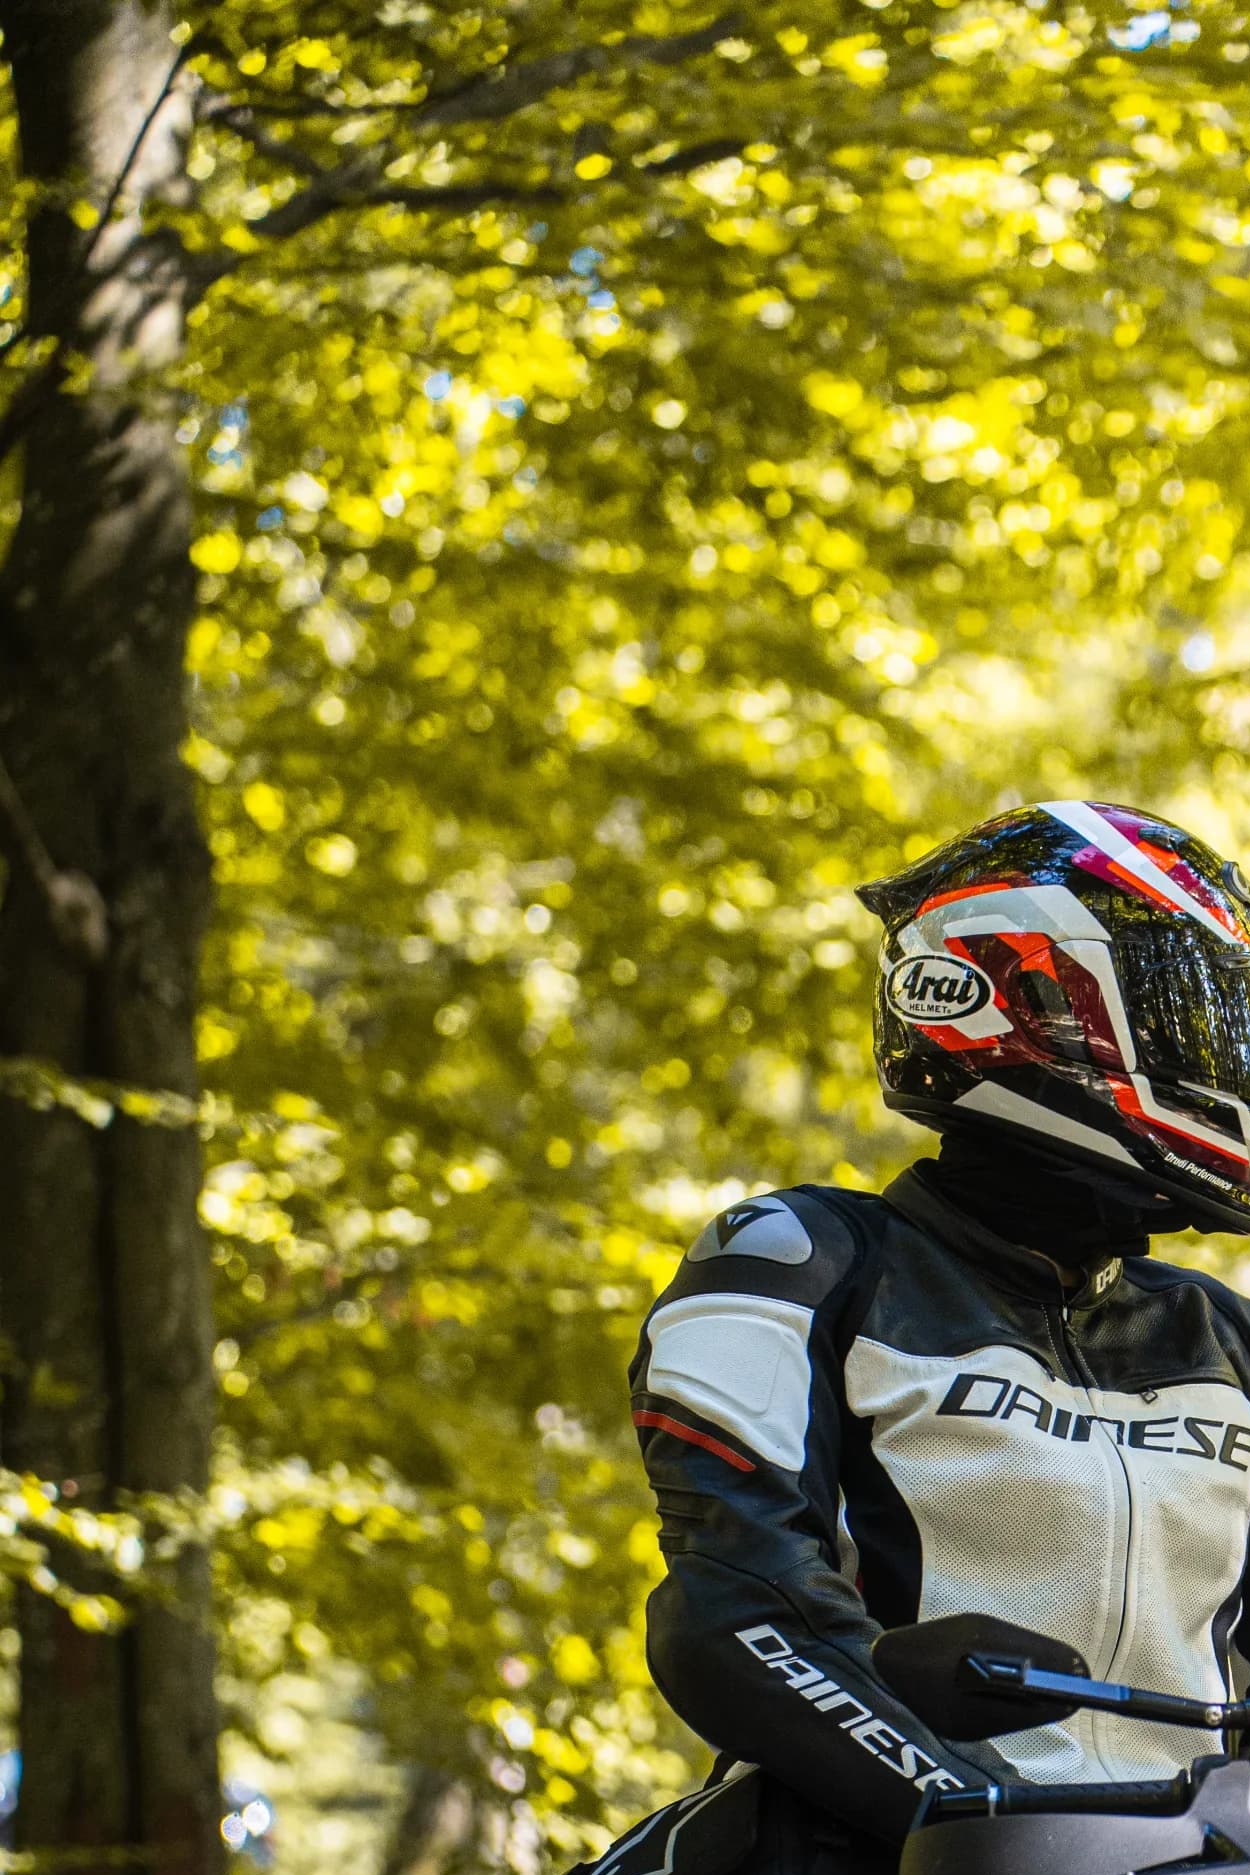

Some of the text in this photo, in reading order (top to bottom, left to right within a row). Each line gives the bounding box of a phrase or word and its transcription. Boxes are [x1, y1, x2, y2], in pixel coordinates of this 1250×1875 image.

[903, 961, 974, 1005] Arai
[909, 1003, 949, 1015] HELMET
[1164, 1152, 1233, 1190] Drudi Performance
[734, 1623, 966, 1792] DAINESE
